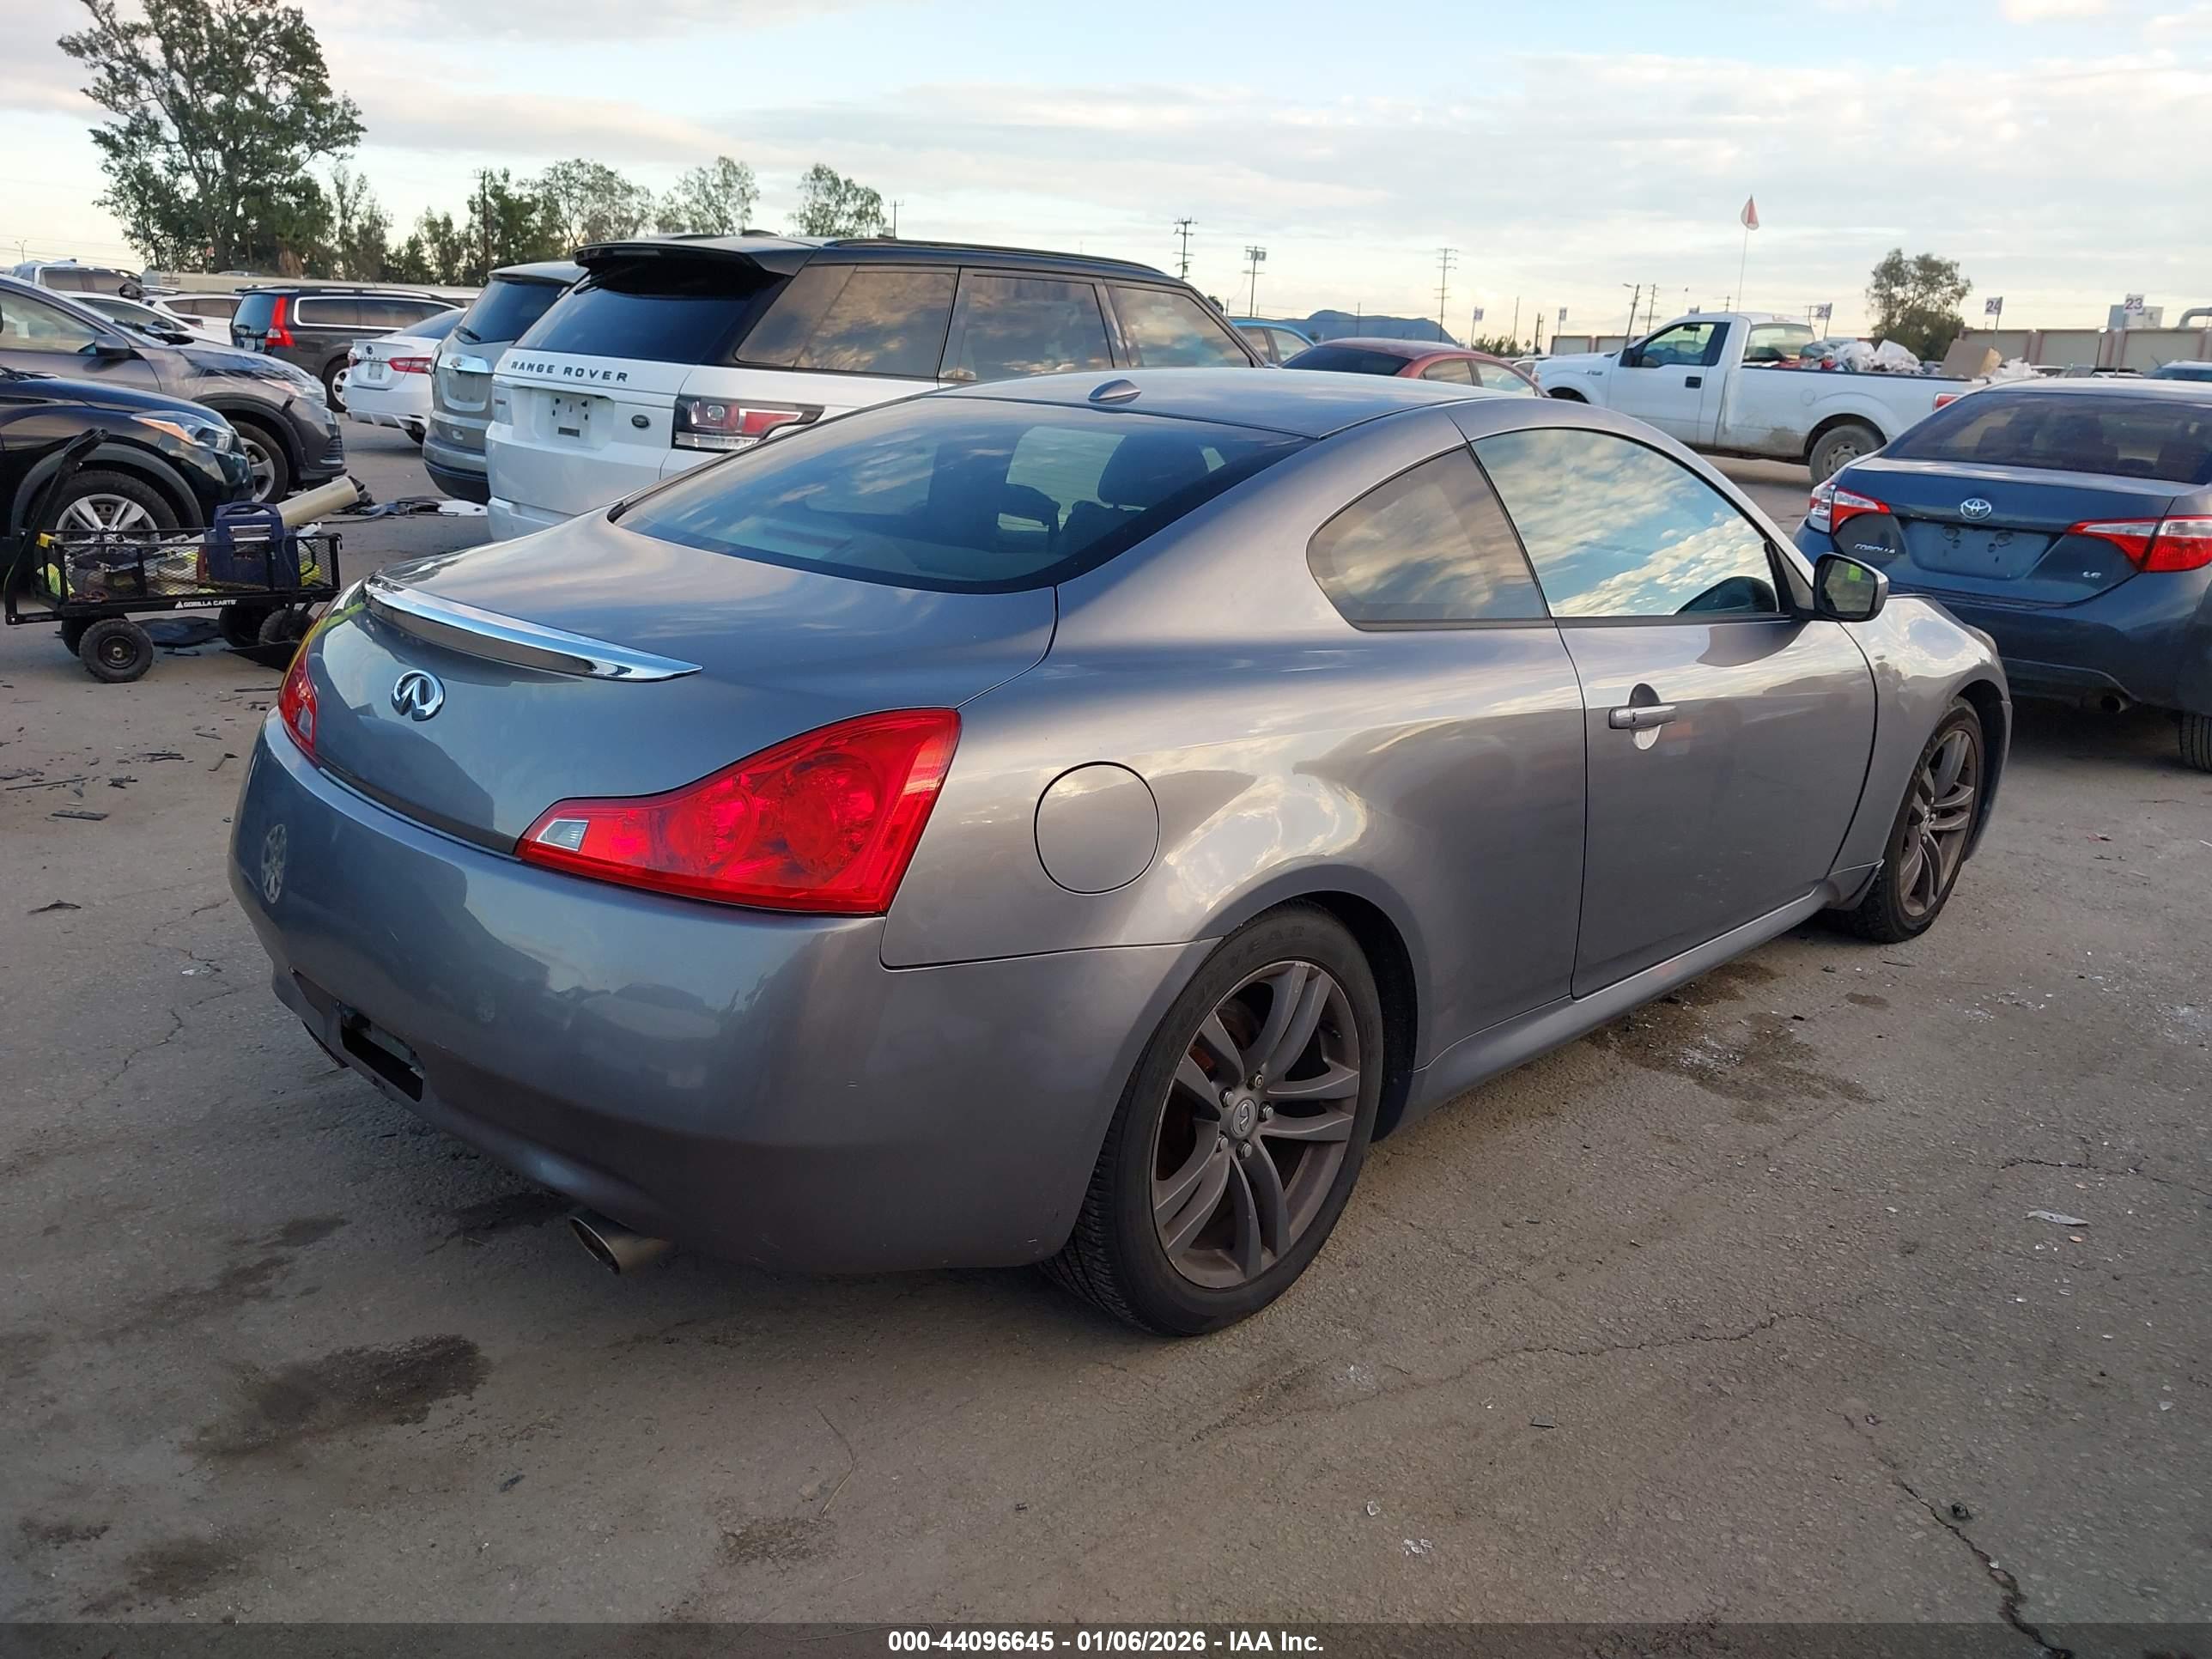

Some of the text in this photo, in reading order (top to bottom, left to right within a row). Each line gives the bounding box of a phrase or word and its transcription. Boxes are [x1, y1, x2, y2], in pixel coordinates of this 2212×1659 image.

[2124, 298, 2142, 310] 23
[511, 361, 629, 382] RANGE ROVER
